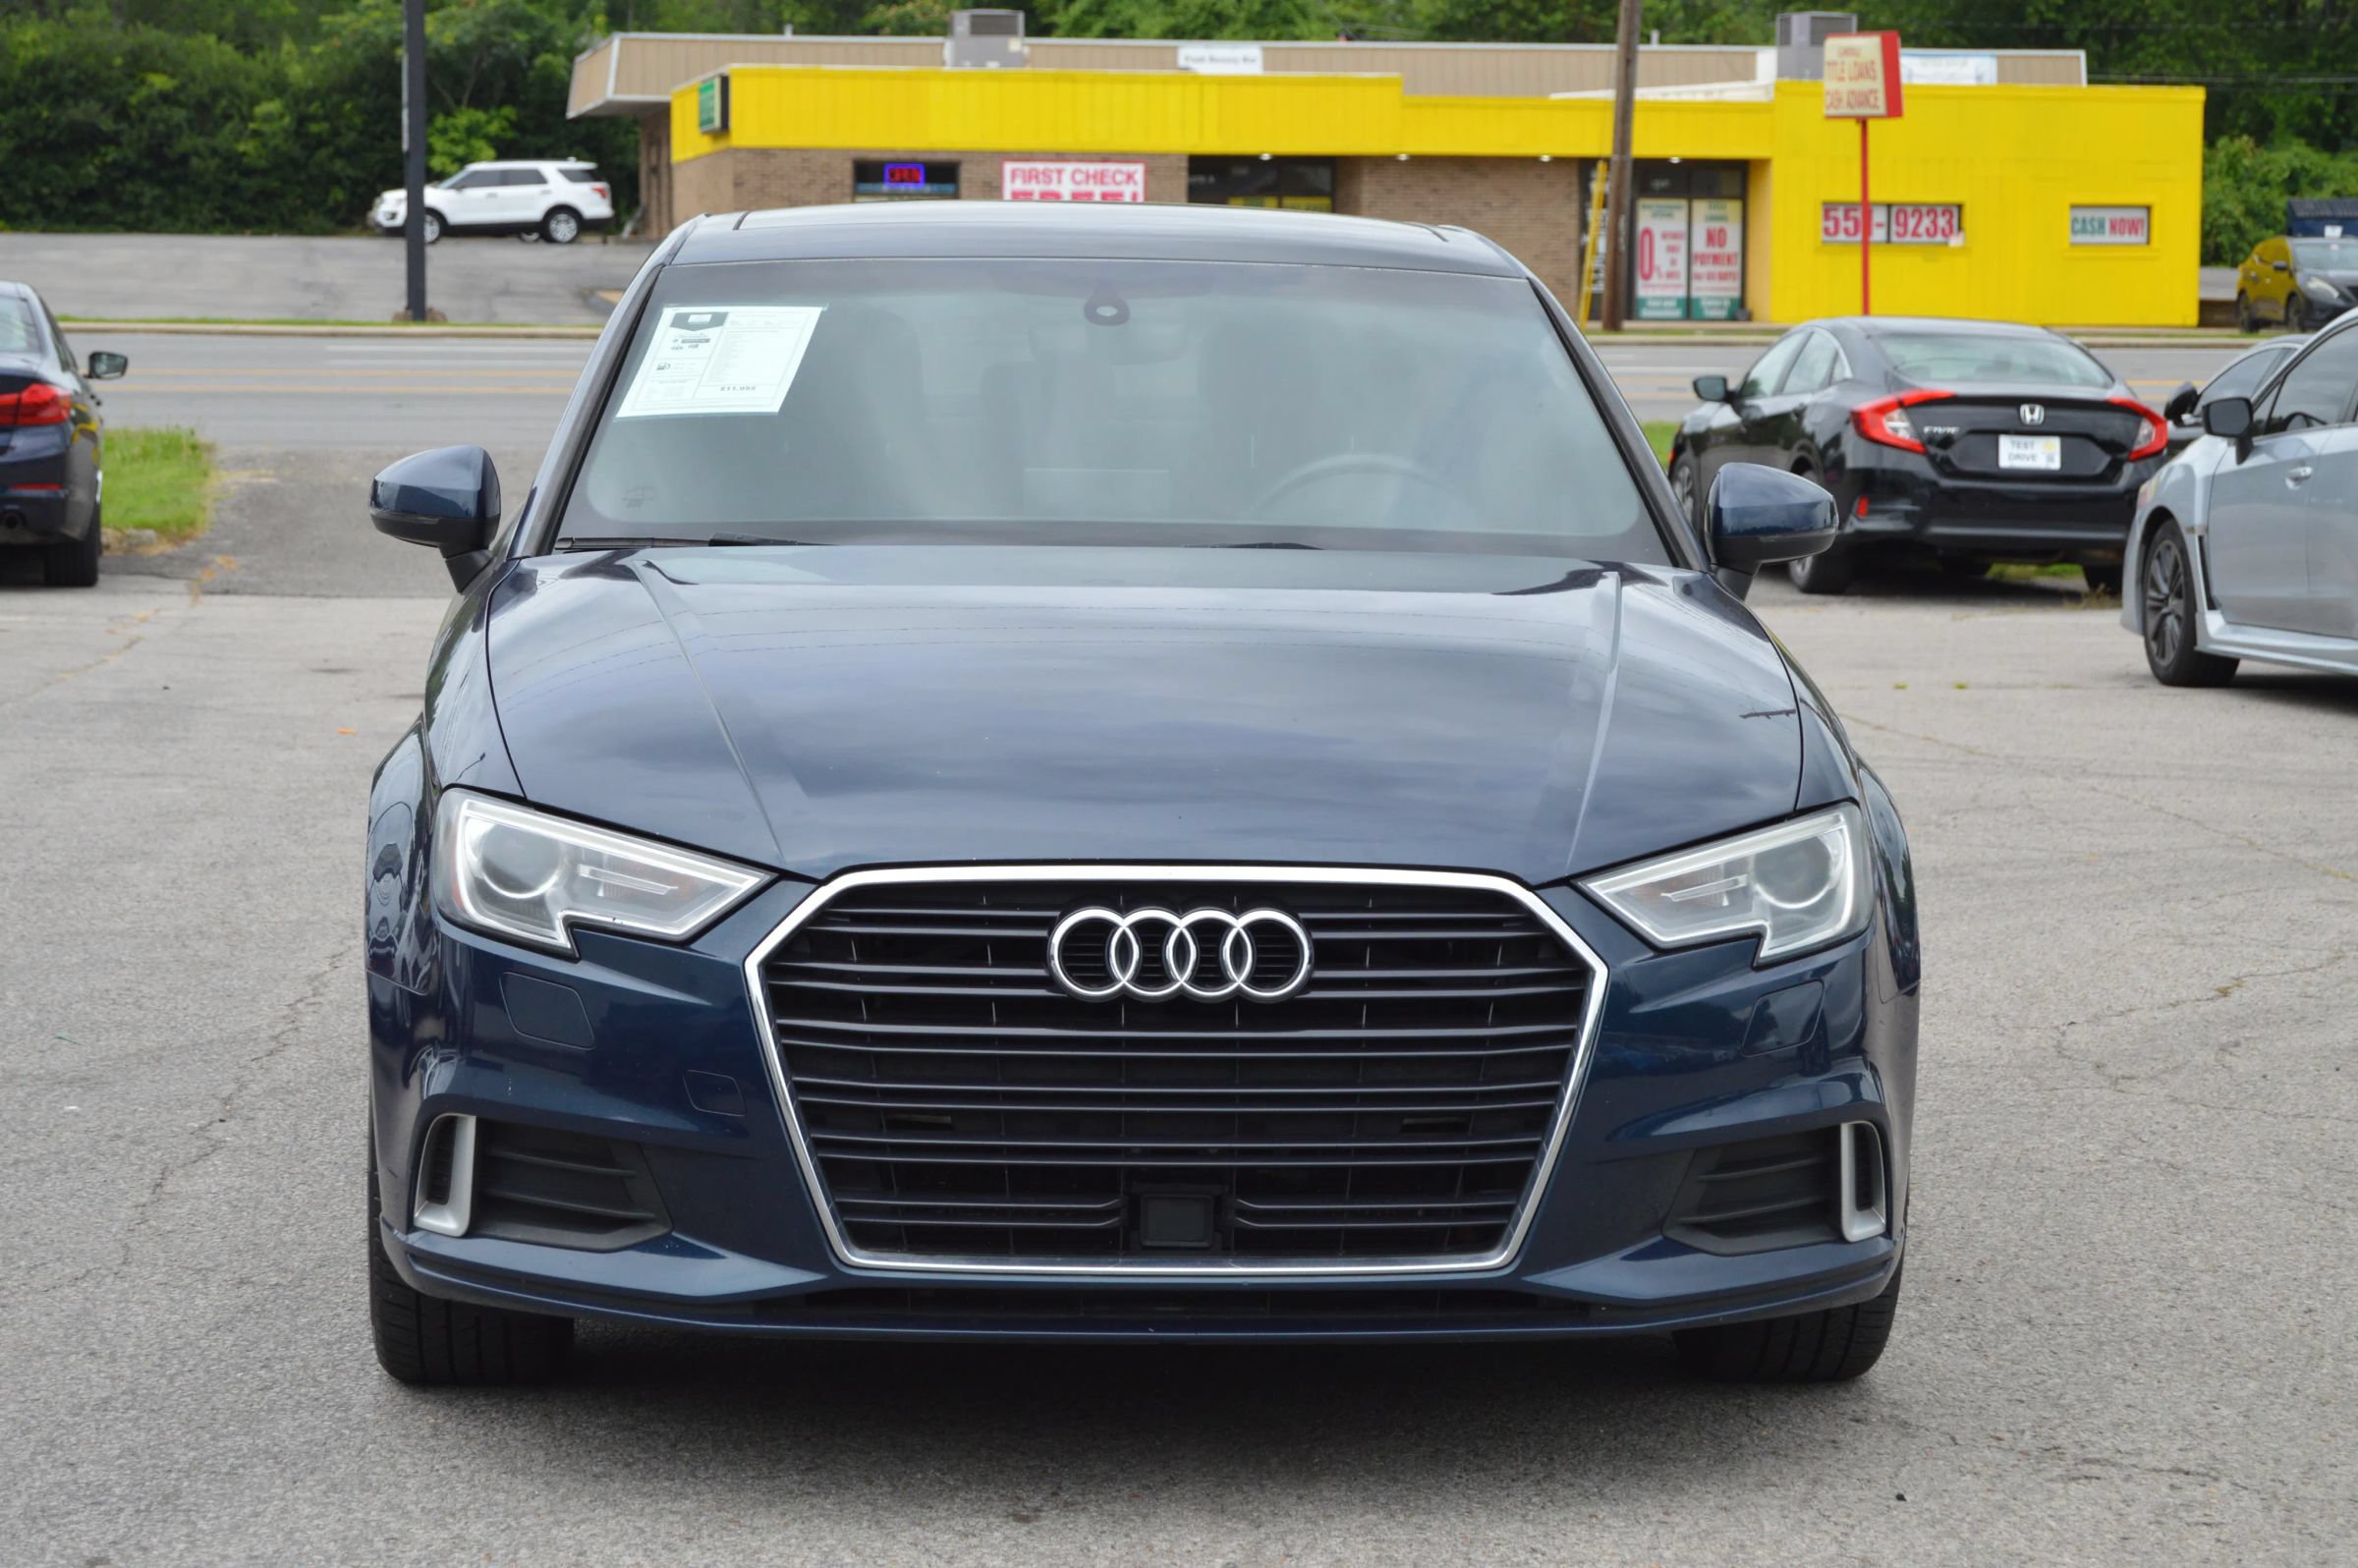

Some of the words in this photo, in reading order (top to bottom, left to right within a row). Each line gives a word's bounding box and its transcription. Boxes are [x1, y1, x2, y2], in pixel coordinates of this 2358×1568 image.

[1848, 60, 1878, 82] LOANS
[1846, 88, 1880, 110] ADVANCE
[1010, 168, 1064, 185] FIRST
[1071, 169, 1138, 186] CHECK
[1824, 206, 1953, 238] 55-9233
[2071, 216, 2105, 236] CASH
[2108, 216, 2145, 236] NOW!
[1706, 227, 1727, 249] NO
[1693, 252, 1738, 266] PAYMENT
[2010, 440, 2036, 450] TEST
[2008, 454, 2038, 463] DRIVE
